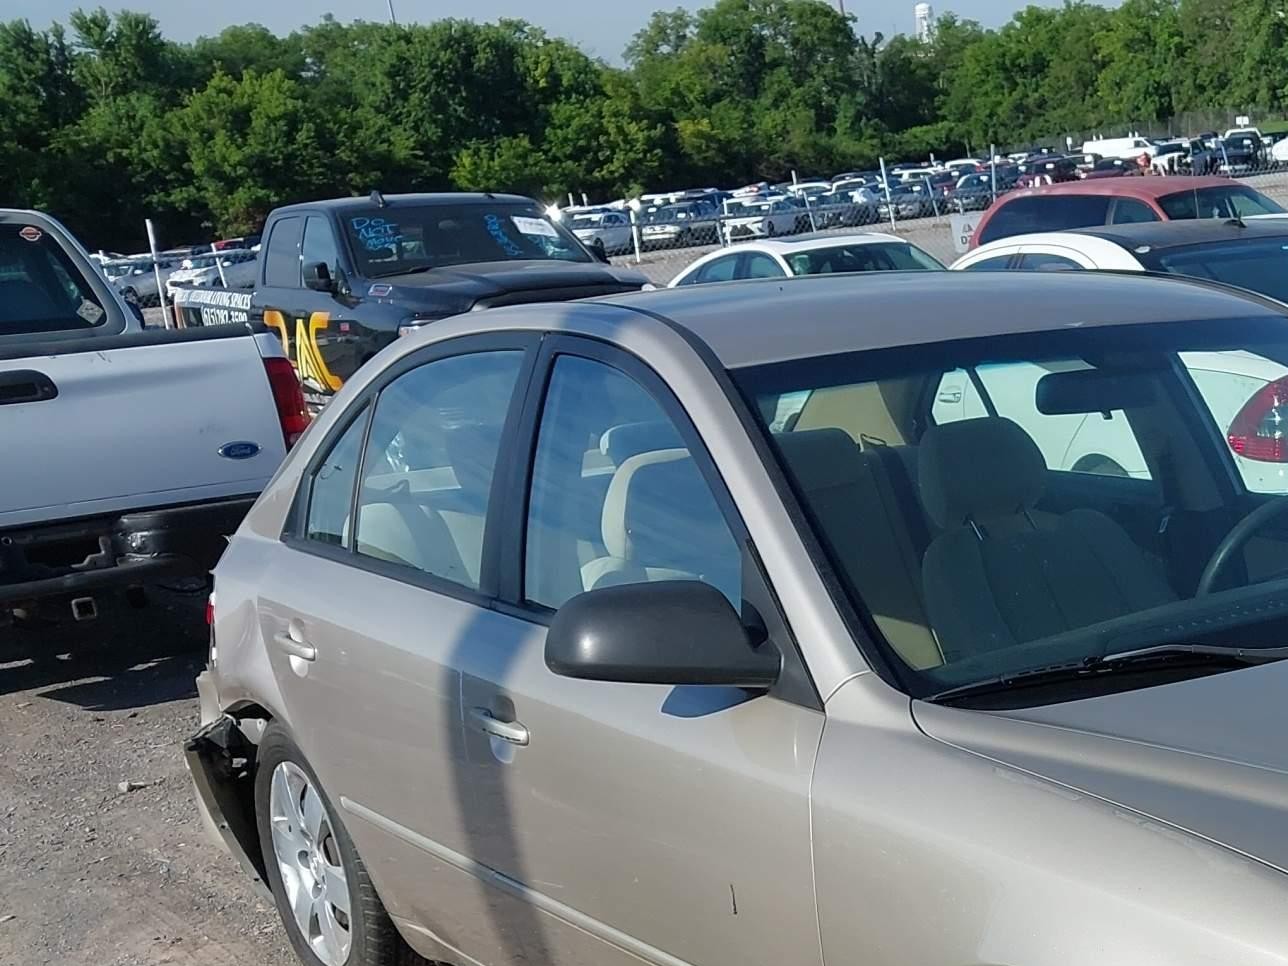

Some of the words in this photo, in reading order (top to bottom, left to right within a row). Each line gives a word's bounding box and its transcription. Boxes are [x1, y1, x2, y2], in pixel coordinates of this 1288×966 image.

[359, 223, 399, 240] NOT
[210, 290, 233, 307] LIVING
[229, 292, 252, 310] SPACES
